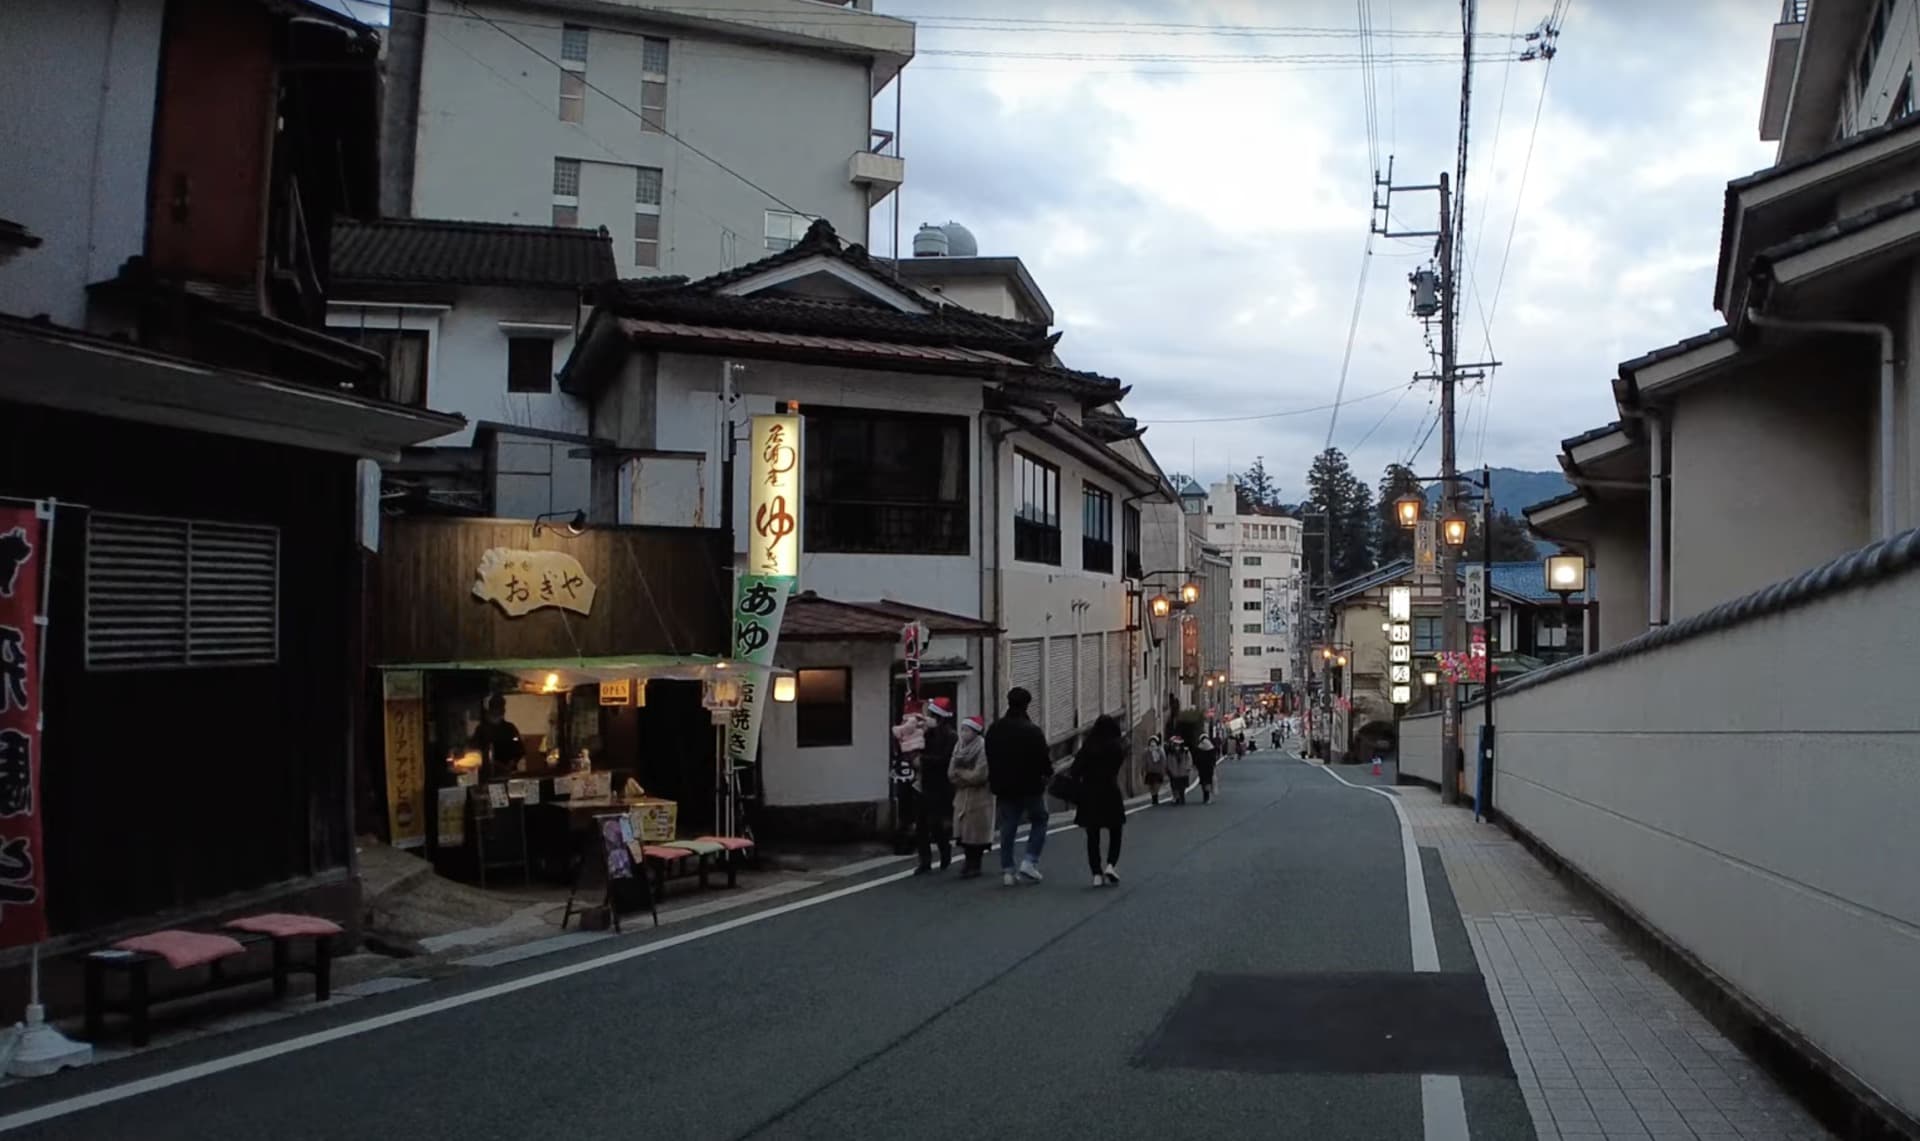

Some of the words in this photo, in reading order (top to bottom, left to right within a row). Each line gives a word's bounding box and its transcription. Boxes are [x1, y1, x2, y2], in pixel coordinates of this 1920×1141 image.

[505, 571, 584, 602] おぎや
[1468, 582, 1482, 620] 小川屋
[393, 710, 409, 800] クリアアサヒ
